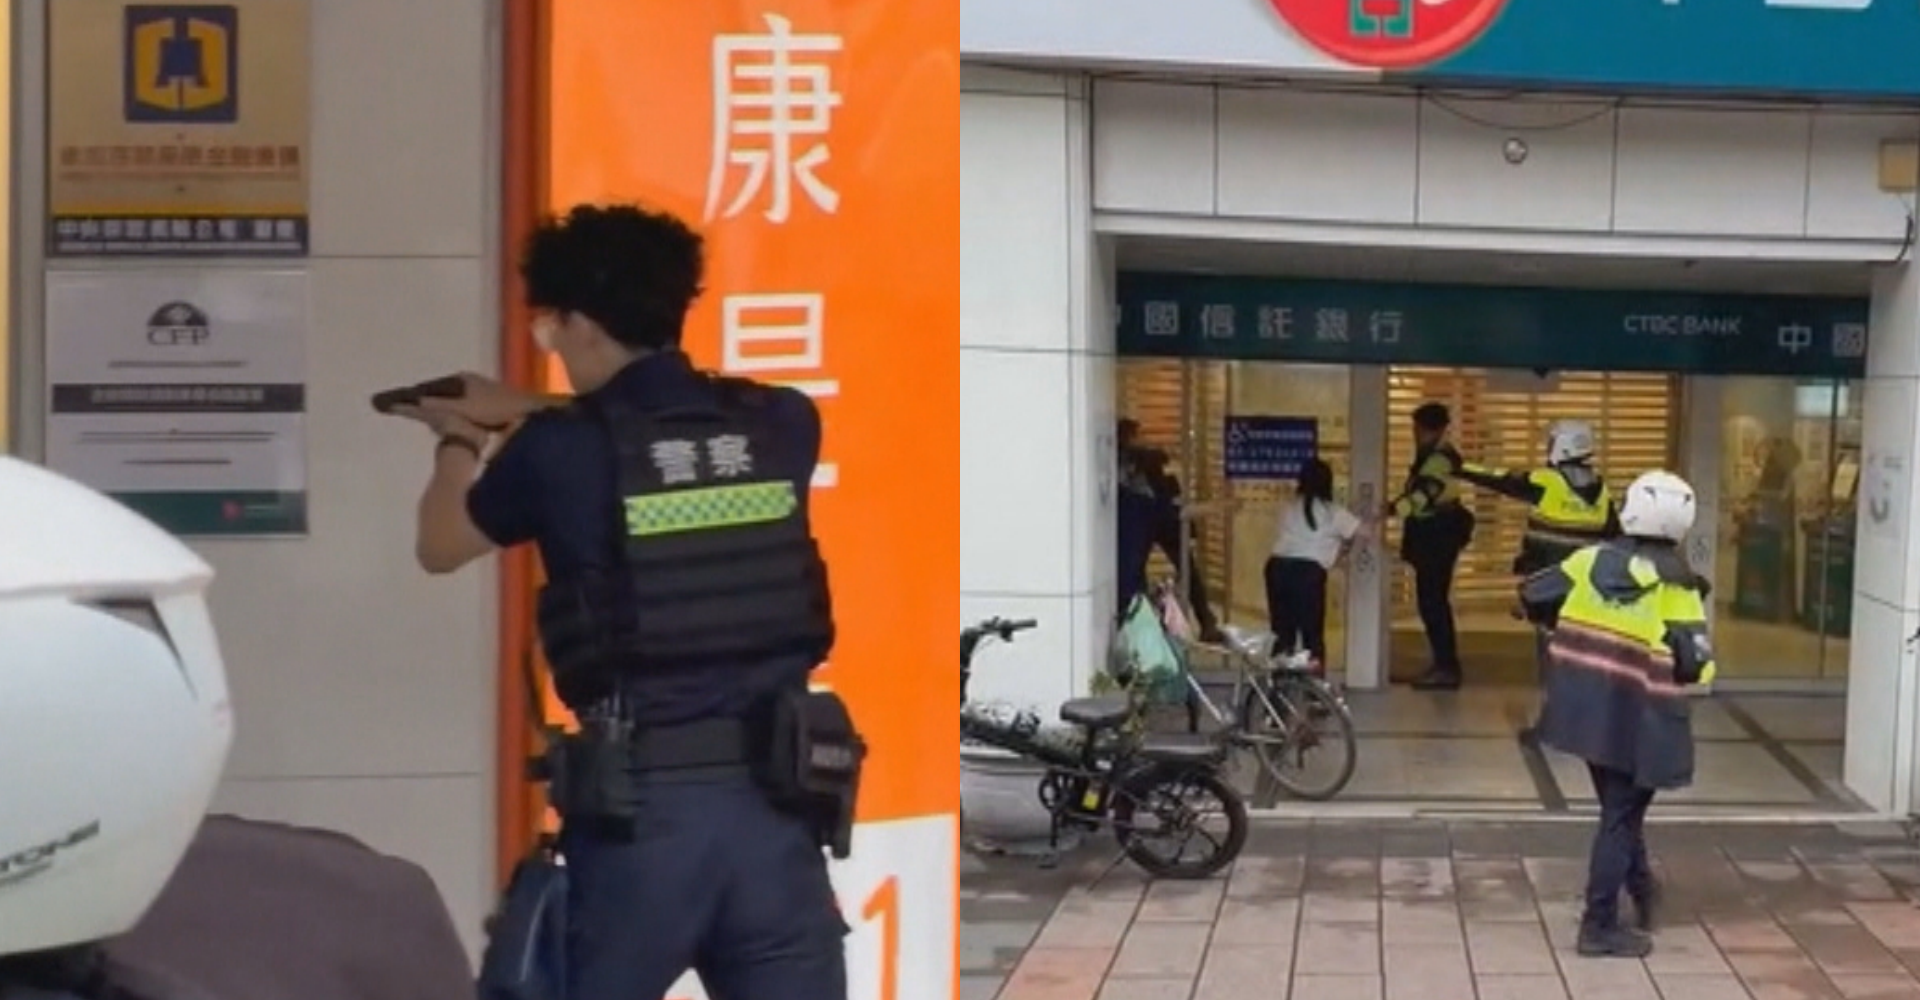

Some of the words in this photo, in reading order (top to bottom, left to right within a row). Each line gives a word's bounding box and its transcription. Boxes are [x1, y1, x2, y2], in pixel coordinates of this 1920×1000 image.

[1623, 314, 1679, 335] CTBC
[1682, 315, 1743, 336] BANK
[649, 434, 753, 485] 警察
